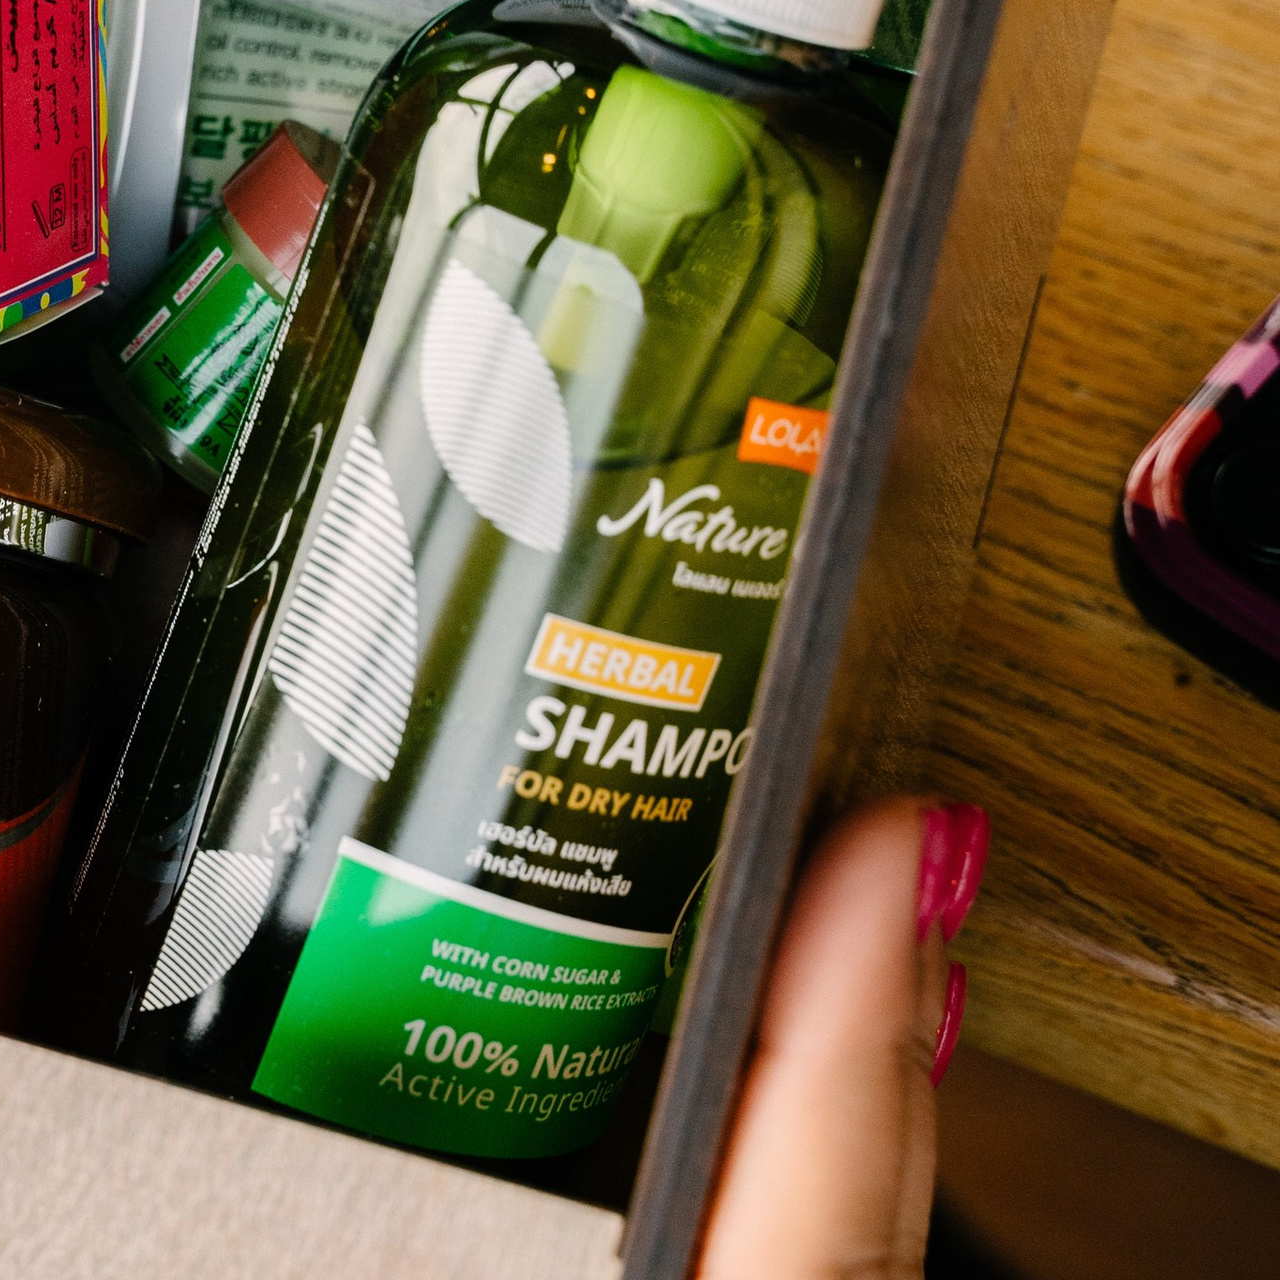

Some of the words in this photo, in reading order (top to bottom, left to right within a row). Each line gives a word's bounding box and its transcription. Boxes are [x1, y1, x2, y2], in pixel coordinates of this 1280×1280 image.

[750, 414, 821, 456] LOLA
[597, 478, 788, 560] Nature
[547, 633, 696, 699] HERBAL
[515, 695, 755, 780] SHAMPO
[497, 764, 561, 805] FOR
[566, 784, 630, 819] DRY
[631, 793, 693, 822] HAIR
[421, 964, 497, 999] PURPLE
[498, 985, 568, 1011] BROWN
[570, 992, 605, 1011] RICE
[431, 938, 489, 971] WITH
[491, 955, 550, 982] CORN
[552, 966, 607, 987] SUGAR
[610, 969, 621, 986] &
[402, 1019, 521, 1078] 100%
[378, 1062, 496, 1111] Active
